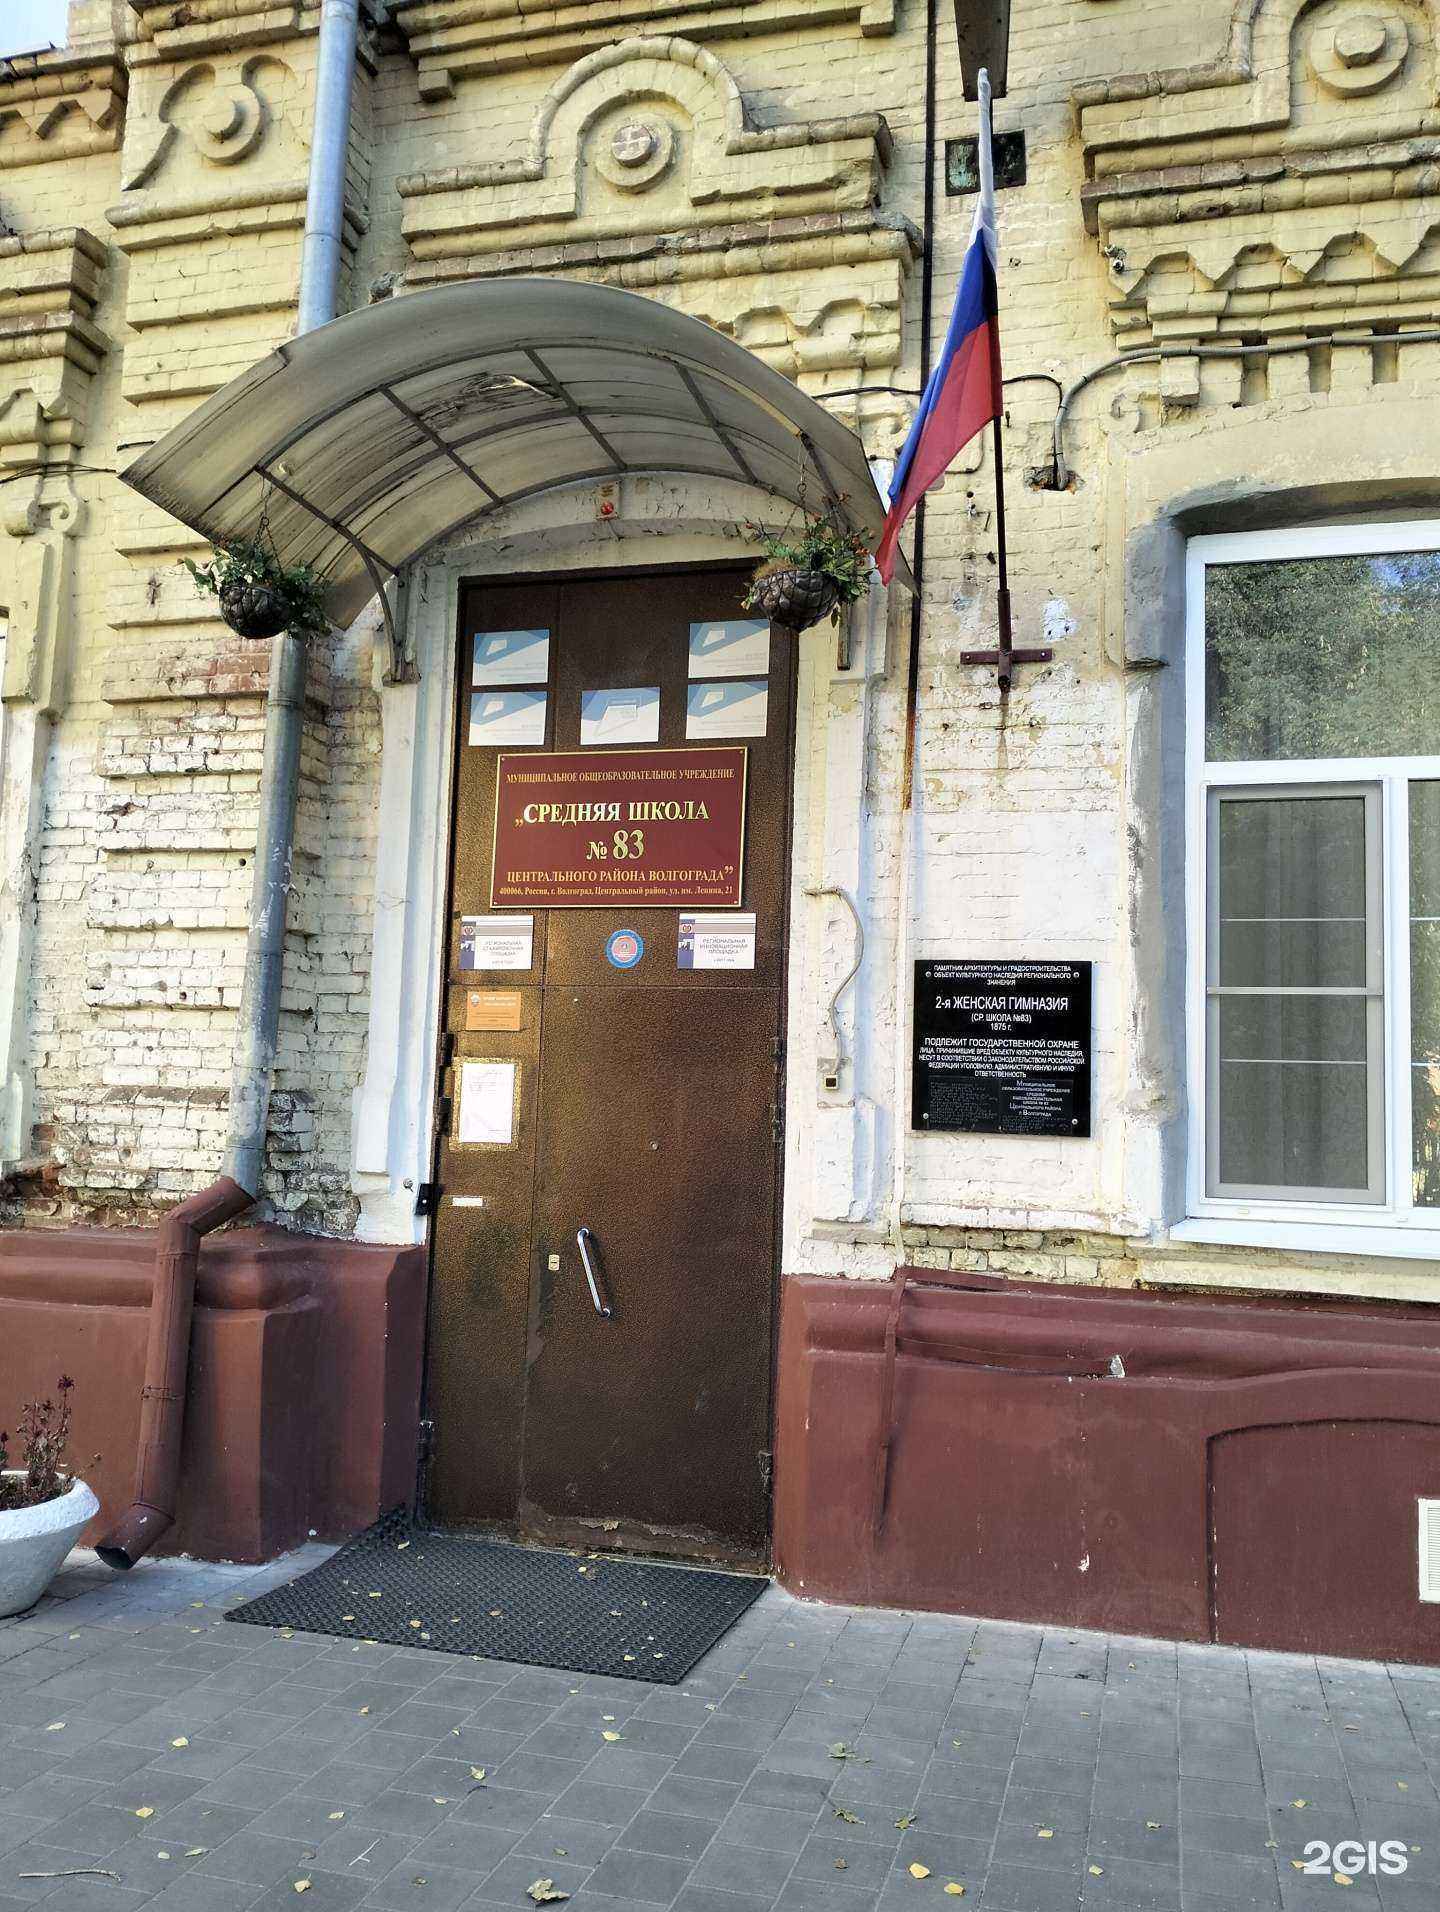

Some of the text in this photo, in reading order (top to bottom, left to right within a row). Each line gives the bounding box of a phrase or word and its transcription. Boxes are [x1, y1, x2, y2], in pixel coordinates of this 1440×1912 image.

[506, 768, 735, 784] МУНИЦИПАЛЬНОЕ ОБЩЕОБРАЗОВАТЕЛЬНОЕ УЧРЕЖДЕНИЕ
[628, 800, 710, 822] ШКОЛА
[586, 829, 645, 860] № 83
[507, 870, 598, 883] ЦЕНТРАЛЬНОГО
[599, 868, 647, 882] РАЙОНА
[594, 886, 643, 896] Центральный
[669, 886, 681, 897] ул.
[725, 885, 734, 895] 21
[935, 996, 1069, 1011] 2-я ЖЕНСКАЯ ГИМНАЗИЯ
[985, 1013, 1012, 1022] ШКОЛА
[990, 1022, 1007, 1031] 1875
[924, 1037, 1080, 1049] ПОДЛЕЖИТ ГОСУДАРСТВЕННОЙ ОХРАНЕ
[941, 1054, 983, 1062] СООТВЕТСТВИИ
[991, 1048, 1016, 1056] ОБЪЕКТУ
[928, 1061, 960, 1069] ФЕДЕРАЦИИ
[994, 1063, 1053, 1071] АДМИНИСТРАТИВНУЮ
[974, 1070, 1027, 1078] ОТВЕТСТВЕННОСТЬ
